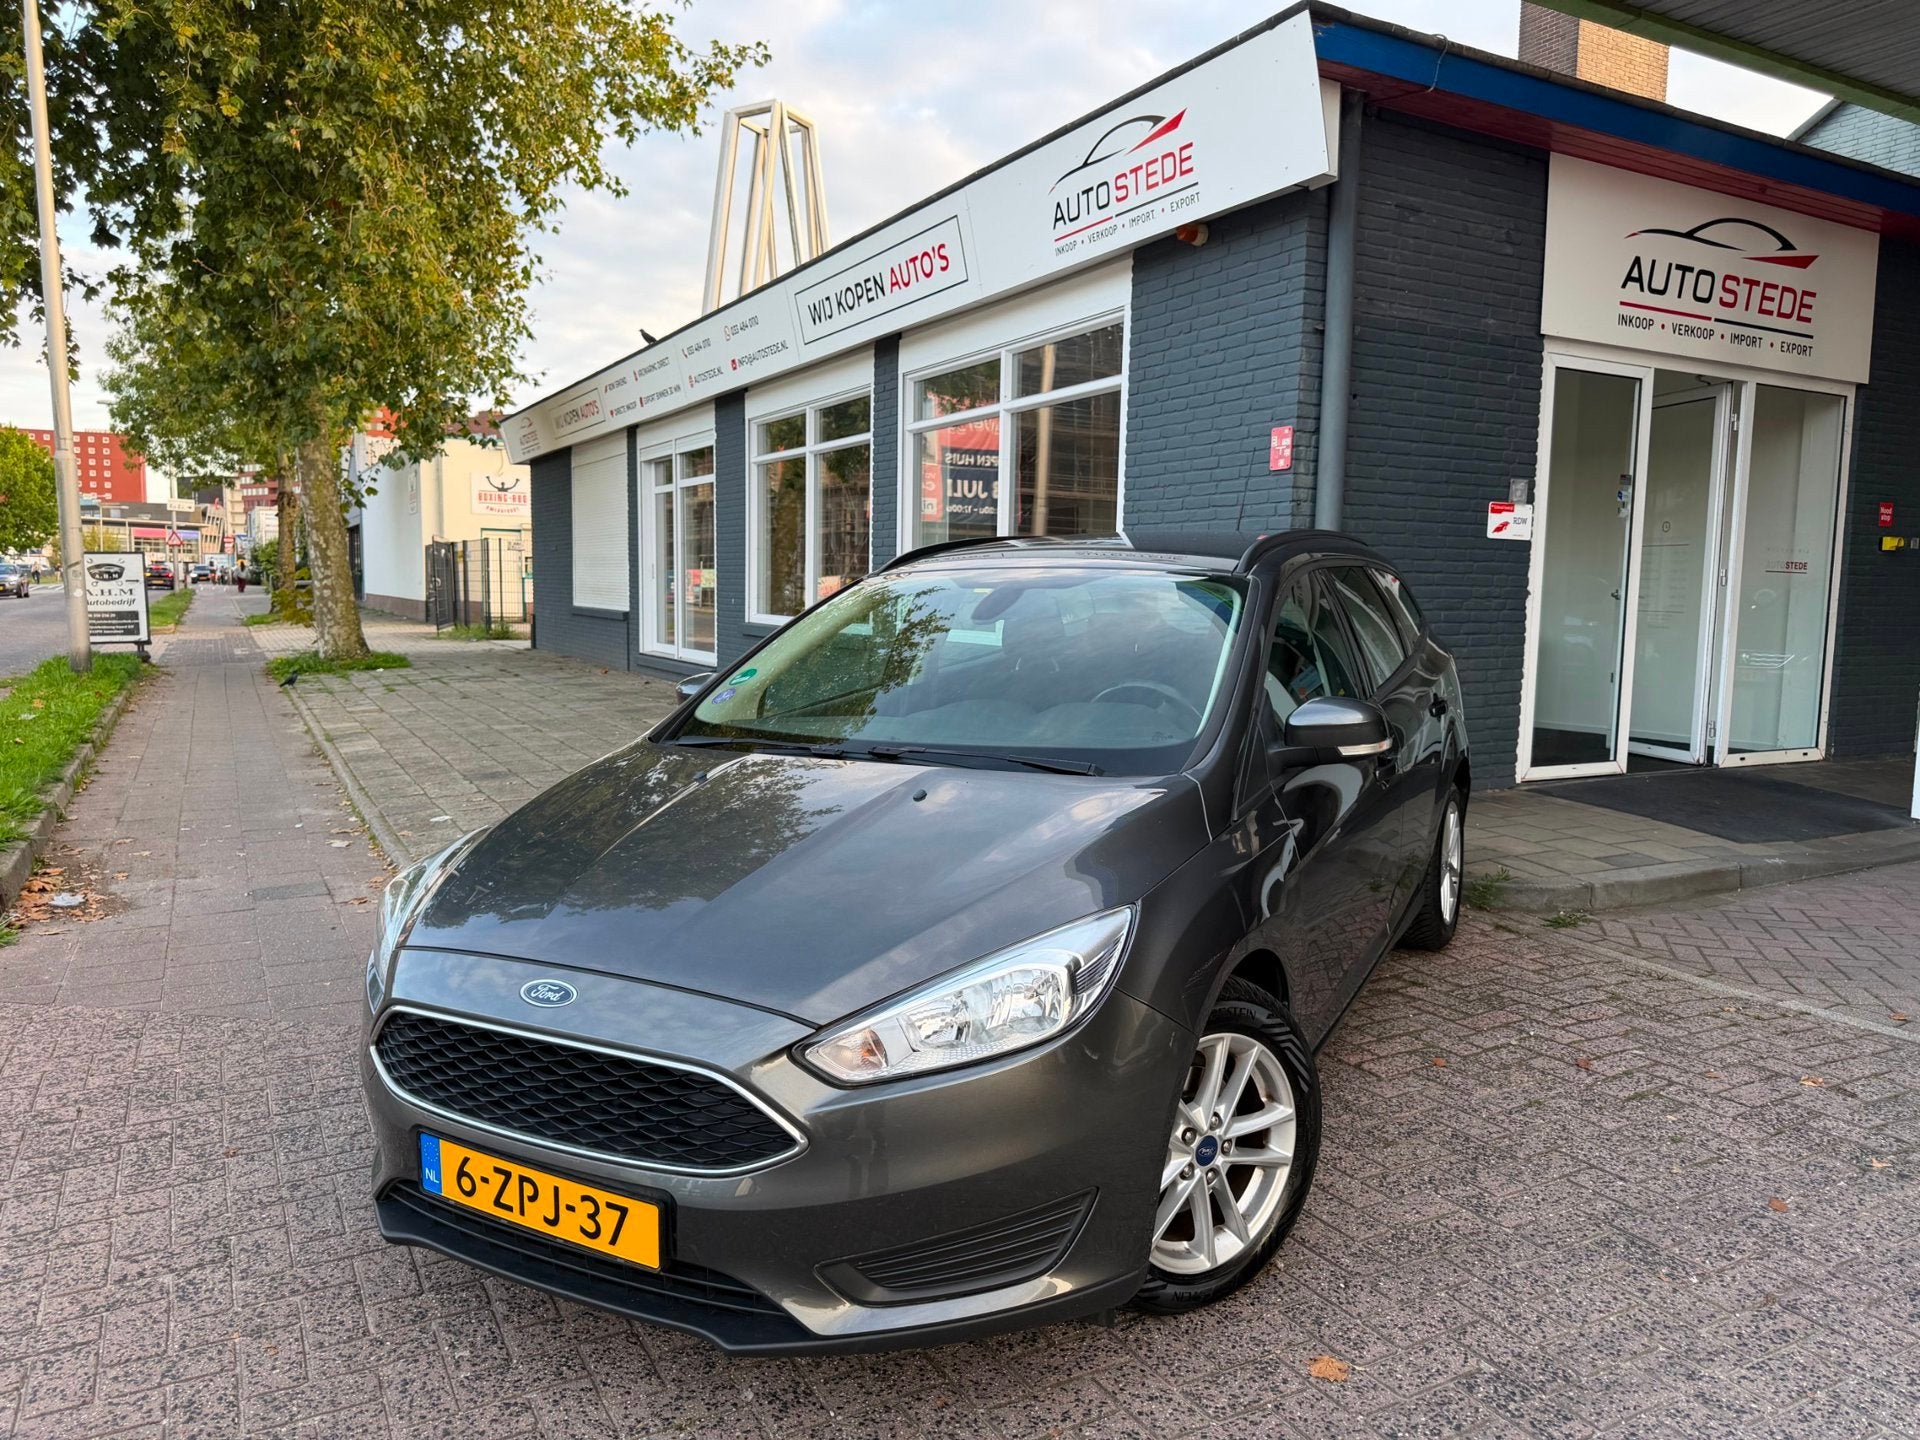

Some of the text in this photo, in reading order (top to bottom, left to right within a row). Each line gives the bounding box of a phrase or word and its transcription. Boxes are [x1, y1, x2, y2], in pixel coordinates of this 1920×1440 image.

[1052, 141, 1194, 230] AUTOSTEDE
[1054, 192, 1201, 257] INKOOP VERKOOP IMPORT EXPORT
[807, 243, 950, 326] WIJ KOPEN AUTO'S
[1620, 255, 1817, 324] AUTOSTEDE
[1617, 313, 1814, 358] INKOOP VERKOOP IMPORT EXPORT
[530, 983, 566, 1002] Ford
[425, 1167, 440, 1184] NL
[455, 1155, 630, 1247] 6-ZPJ-37
